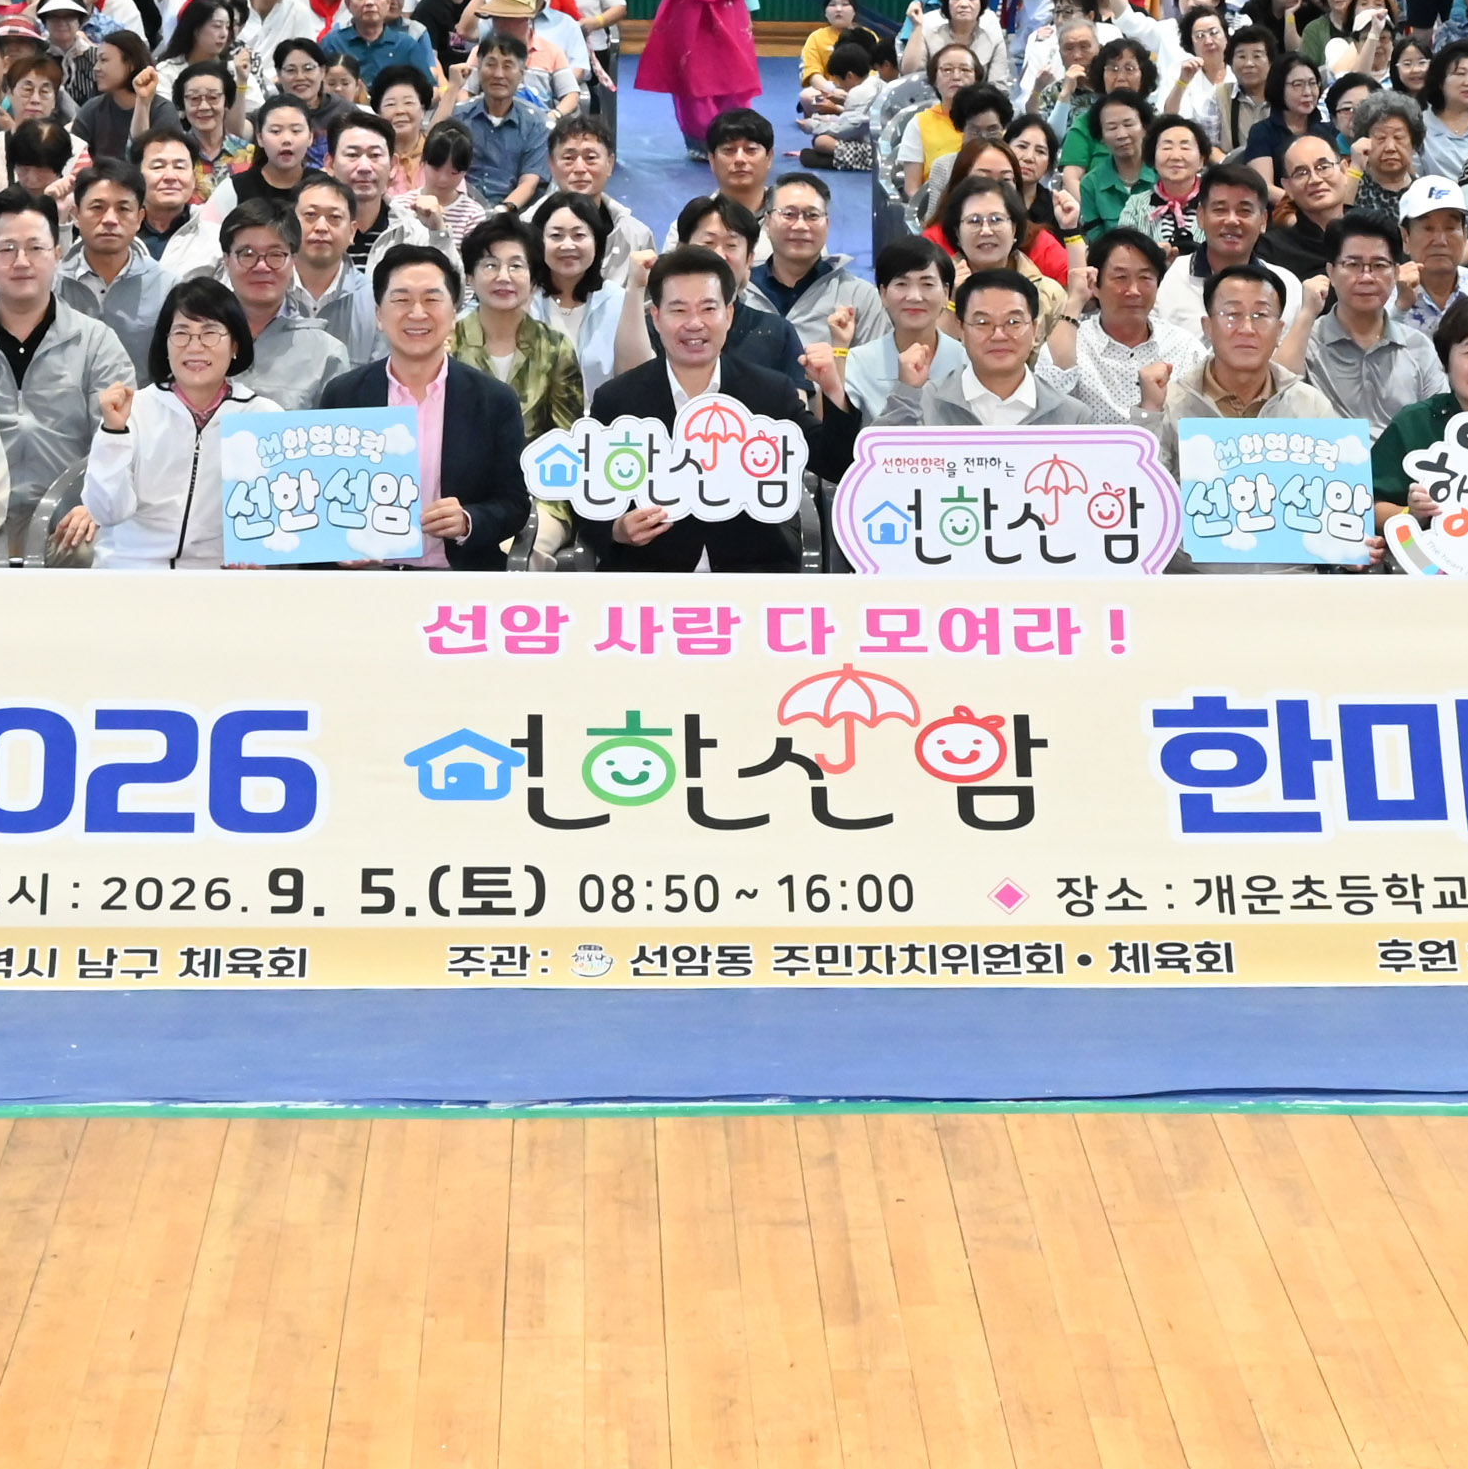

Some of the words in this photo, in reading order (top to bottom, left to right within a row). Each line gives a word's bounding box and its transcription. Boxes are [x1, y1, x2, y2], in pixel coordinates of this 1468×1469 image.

[256, 423, 386, 468] 선한영향력
[1213, 431, 1340, 471] 선한영향력
[225, 468, 320, 541] 선한
[323, 467, 420, 535] 선암
[1185, 473, 1278, 537] 선한
[1279, 473, 1373, 542] 선암
[423, 606, 570, 655] 선암
[594, 606, 740, 655] 사람
[766, 607, 835, 655] 다
[859, 607, 1080, 655] 모여라
[100, 877, 248, 912] 2026.
[578, 874, 719, 913] 08:50
[778, 873, 914, 912] 16:00
[1056, 876, 1147, 916] 장소
[78, 946, 160, 979] 남구
[179, 946, 308, 979] 체육회
[630, 945, 753, 976] 선암동
[1109, 940, 1233, 974] 체육회
